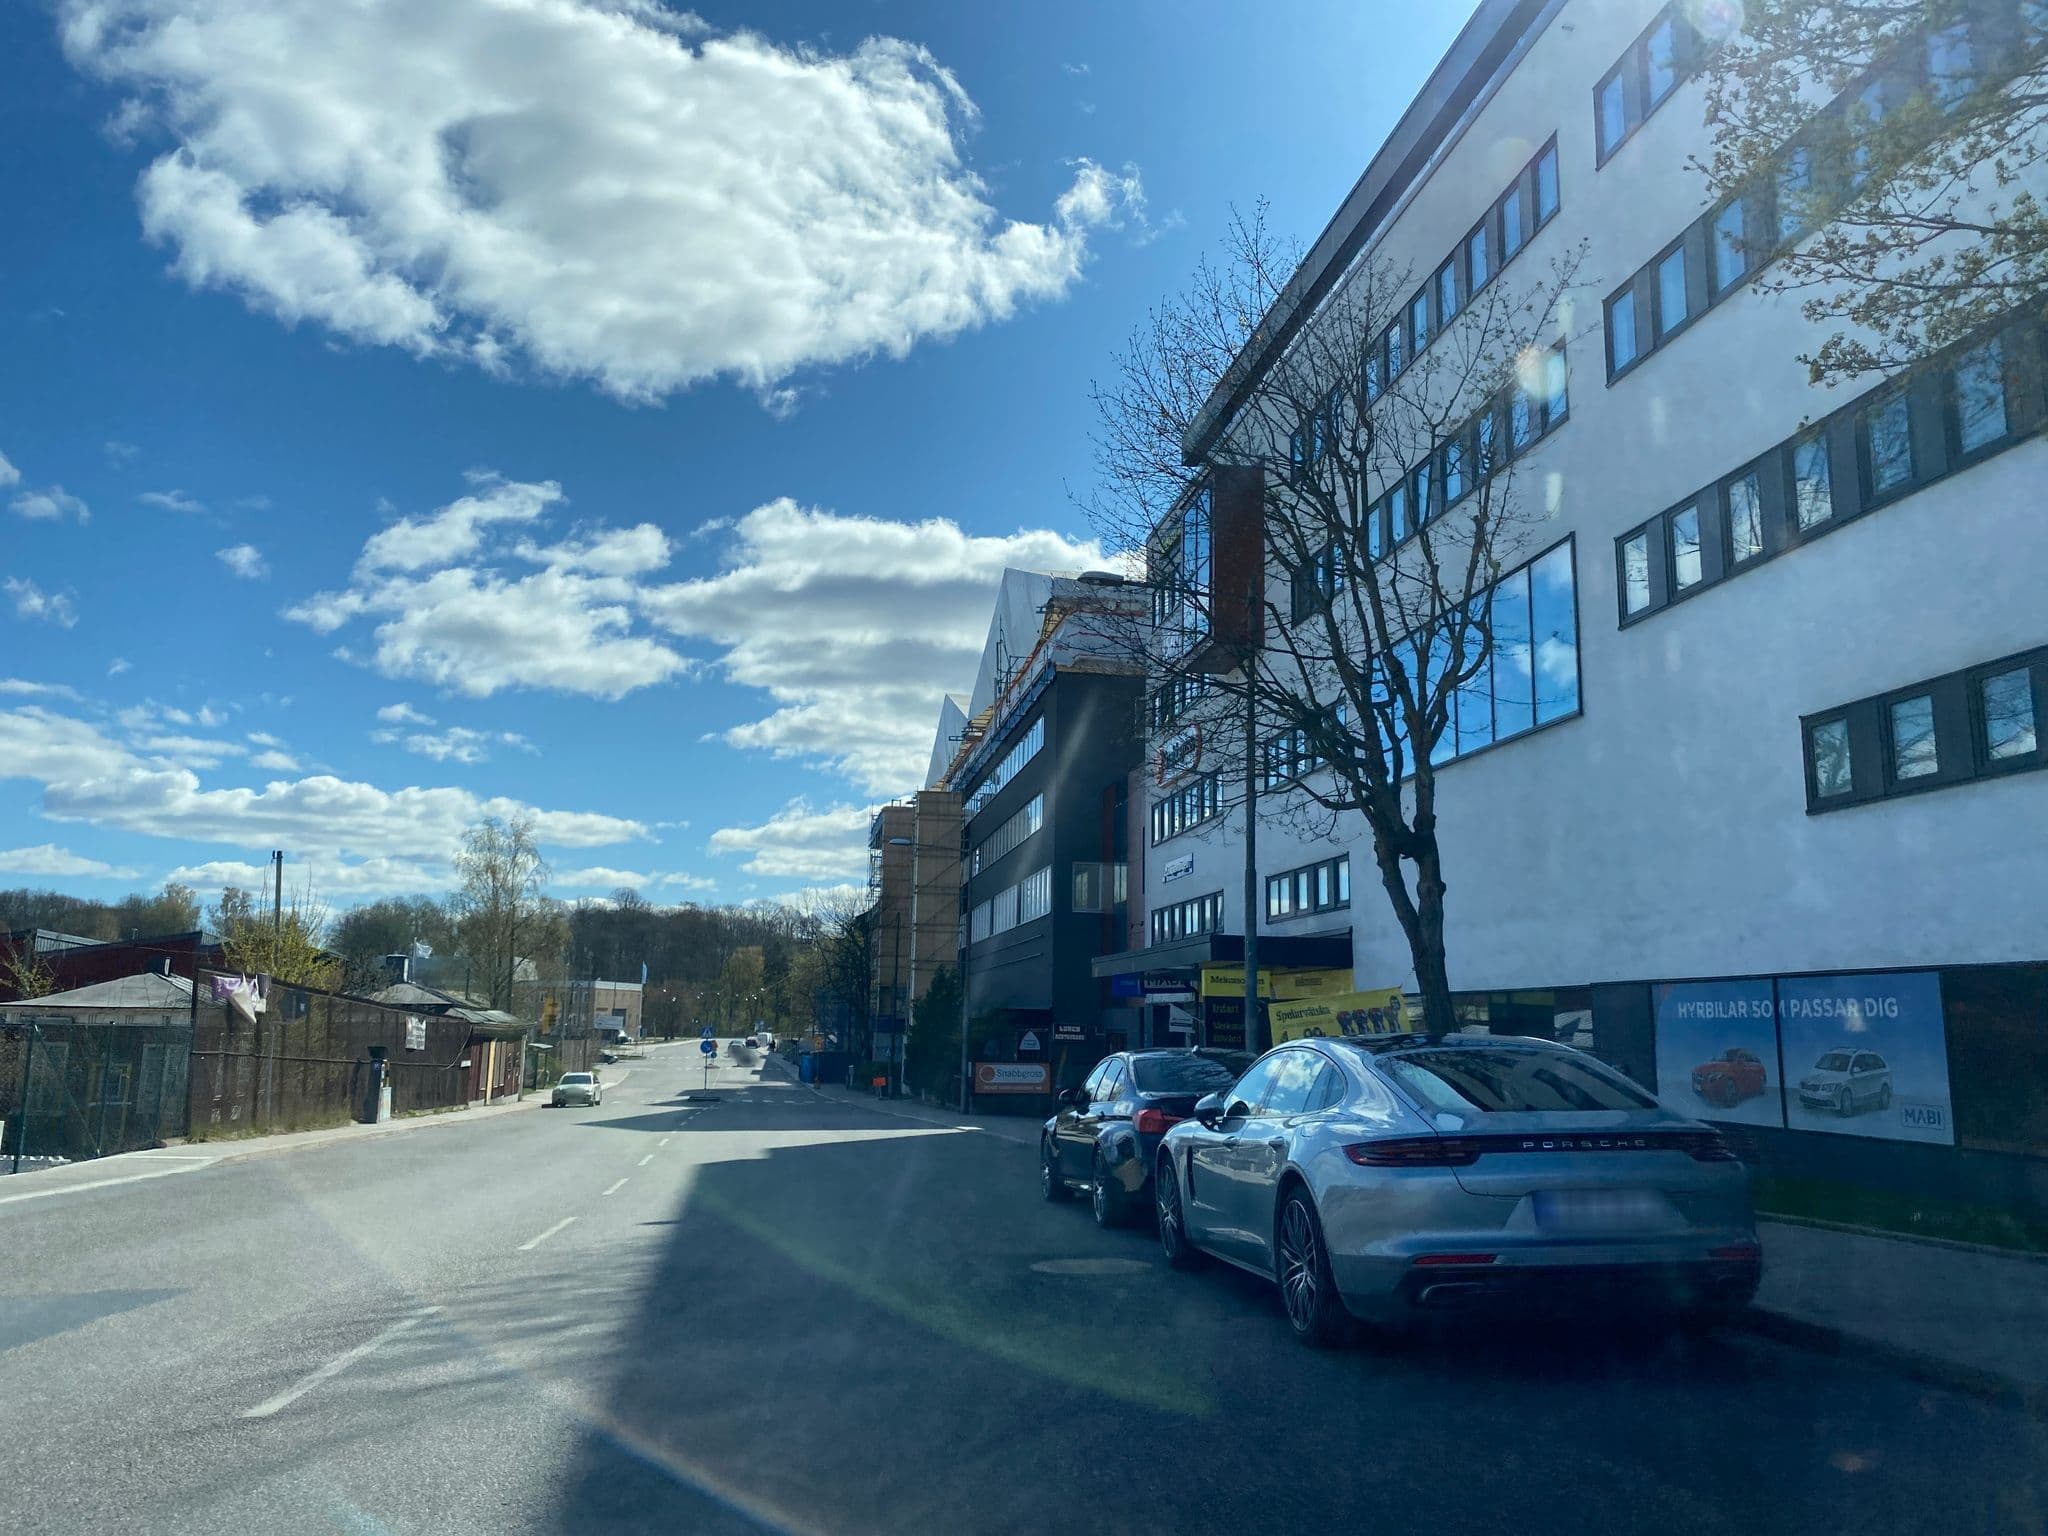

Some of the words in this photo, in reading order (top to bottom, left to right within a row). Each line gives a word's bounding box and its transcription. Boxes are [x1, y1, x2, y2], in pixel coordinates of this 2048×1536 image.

[1210, 975, 1265, 984] Mekonon
[1677, 1001, 1748, 1019] HYRBILAR
[1790, 997, 1859, 1018] PASSAR
[1864, 997, 1899, 1018] DIG
[1904, 1108, 1941, 1126] MABI
[1522, 1138, 1646, 1149] PORSCHE
